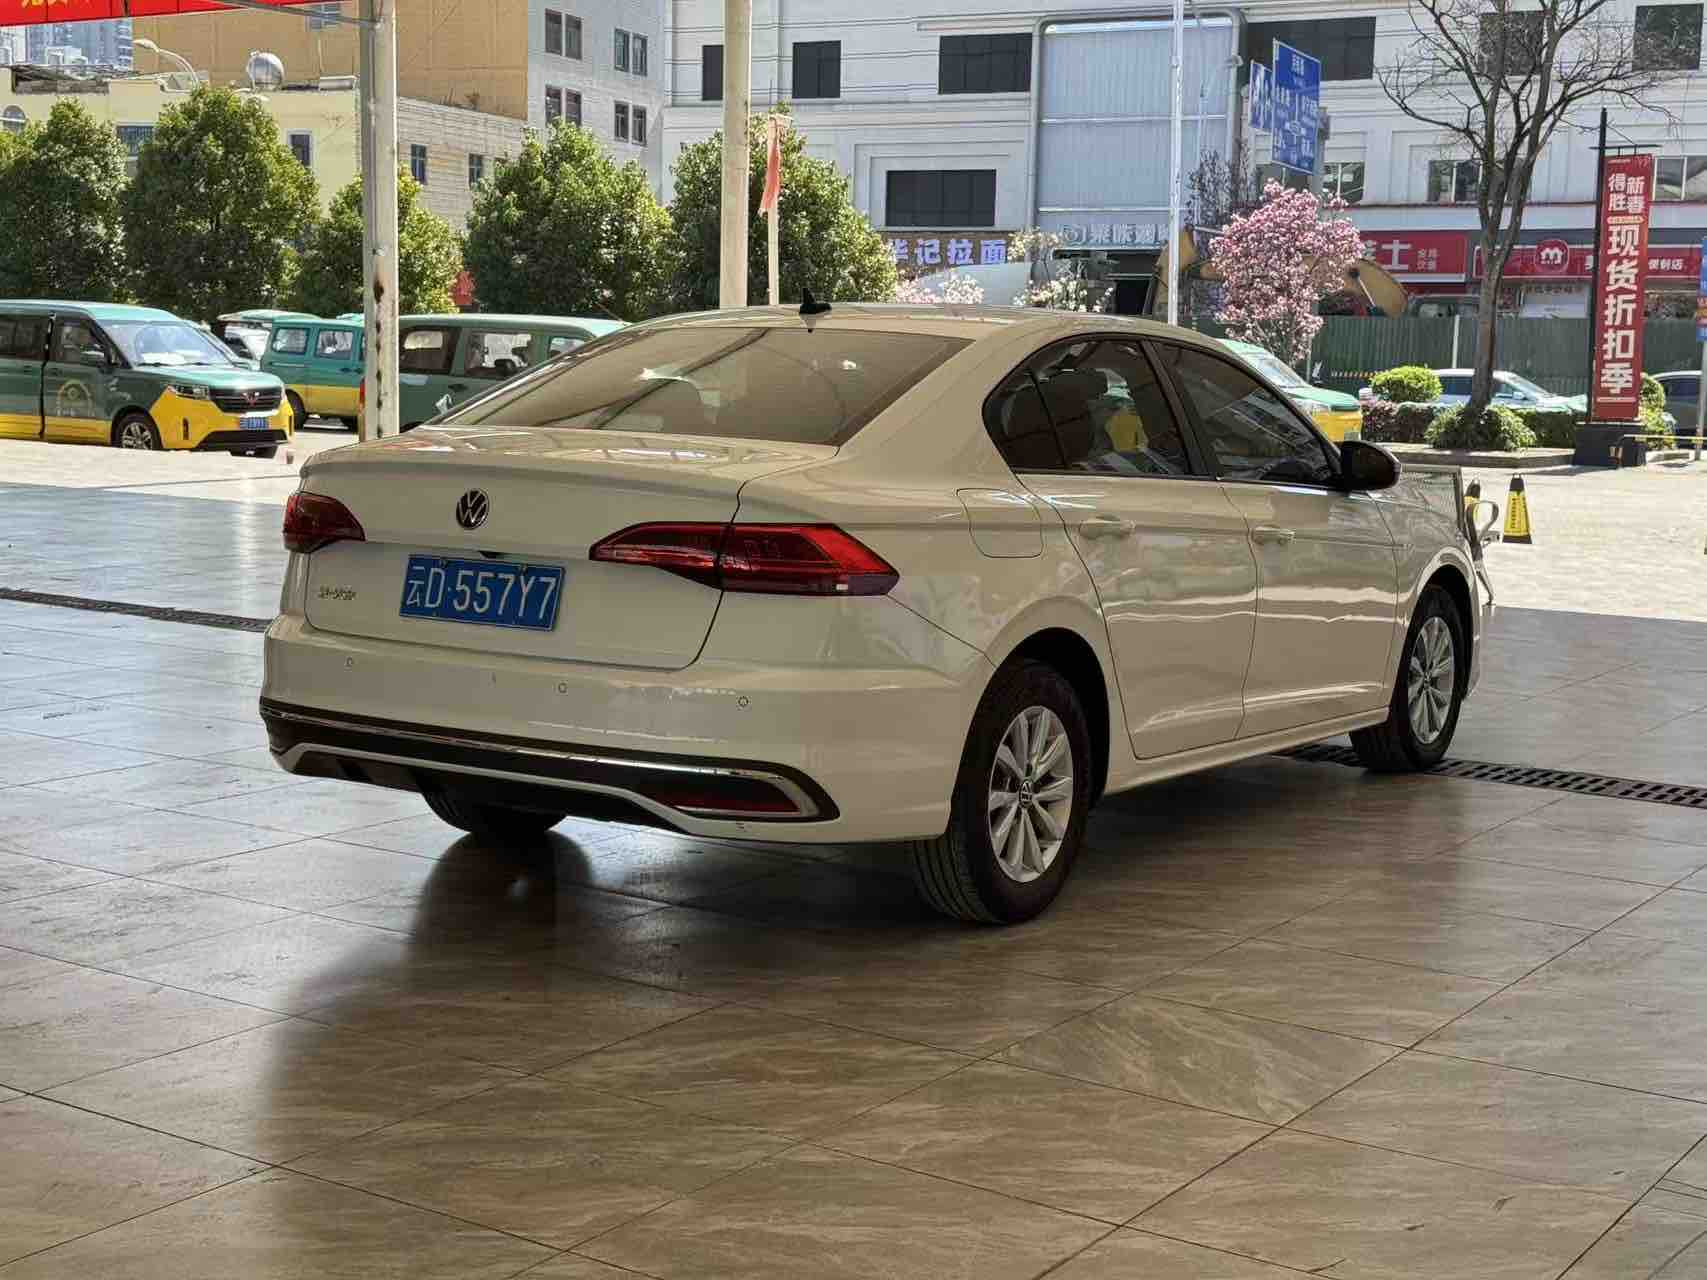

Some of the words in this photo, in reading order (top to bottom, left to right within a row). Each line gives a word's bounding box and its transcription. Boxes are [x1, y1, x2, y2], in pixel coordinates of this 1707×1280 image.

[1608, 173, 1627, 211] 得胜
[1626, 175, 1646, 214] 新春
[1600, 224, 1640, 394] 现货折扣季
